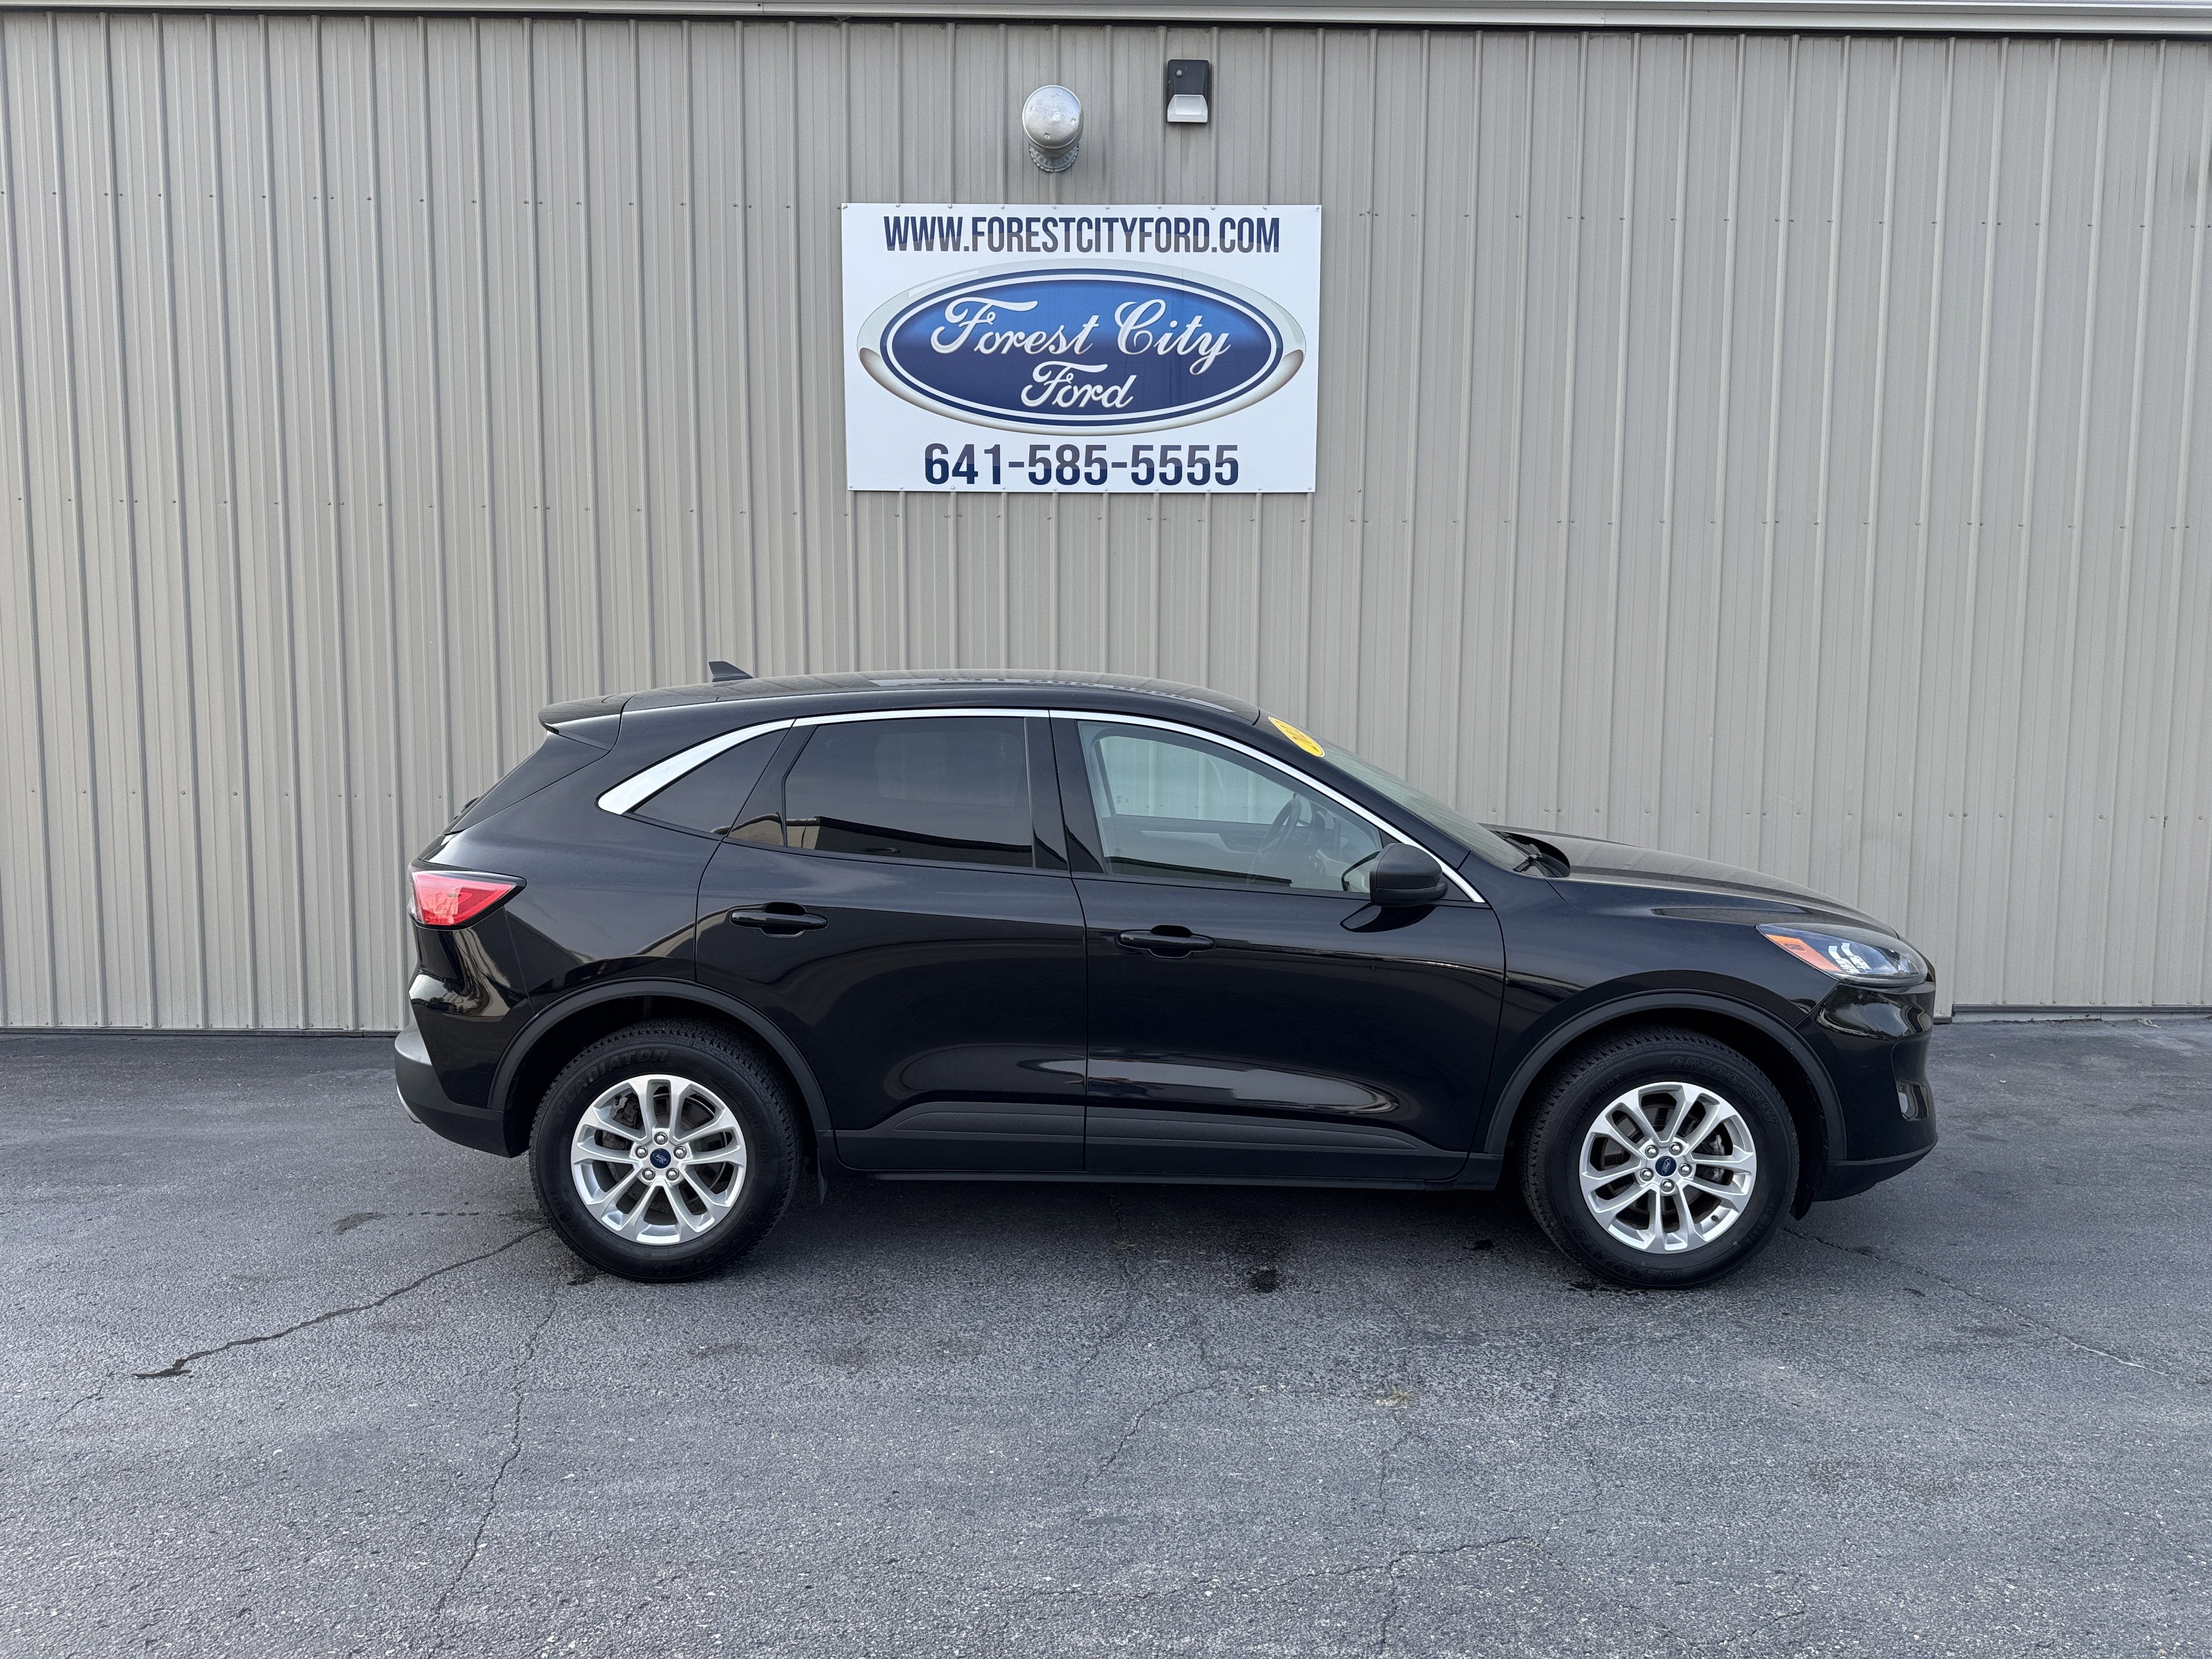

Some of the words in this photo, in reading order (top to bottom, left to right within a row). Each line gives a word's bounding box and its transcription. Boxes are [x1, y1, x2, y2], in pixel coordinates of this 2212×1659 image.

[884, 216, 1280, 253] WWW.FORESTCITYFORD.COM
[930, 297, 1099, 355] Forest
[1114, 299, 1231, 376] City
[1020, 360, 1137, 409] Ford
[924, 443, 1239, 486] 641-585-5555
[555, 1048, 669, 1115] GLADIATOR
[1668, 1055, 1778, 1125] QR700-SUV
